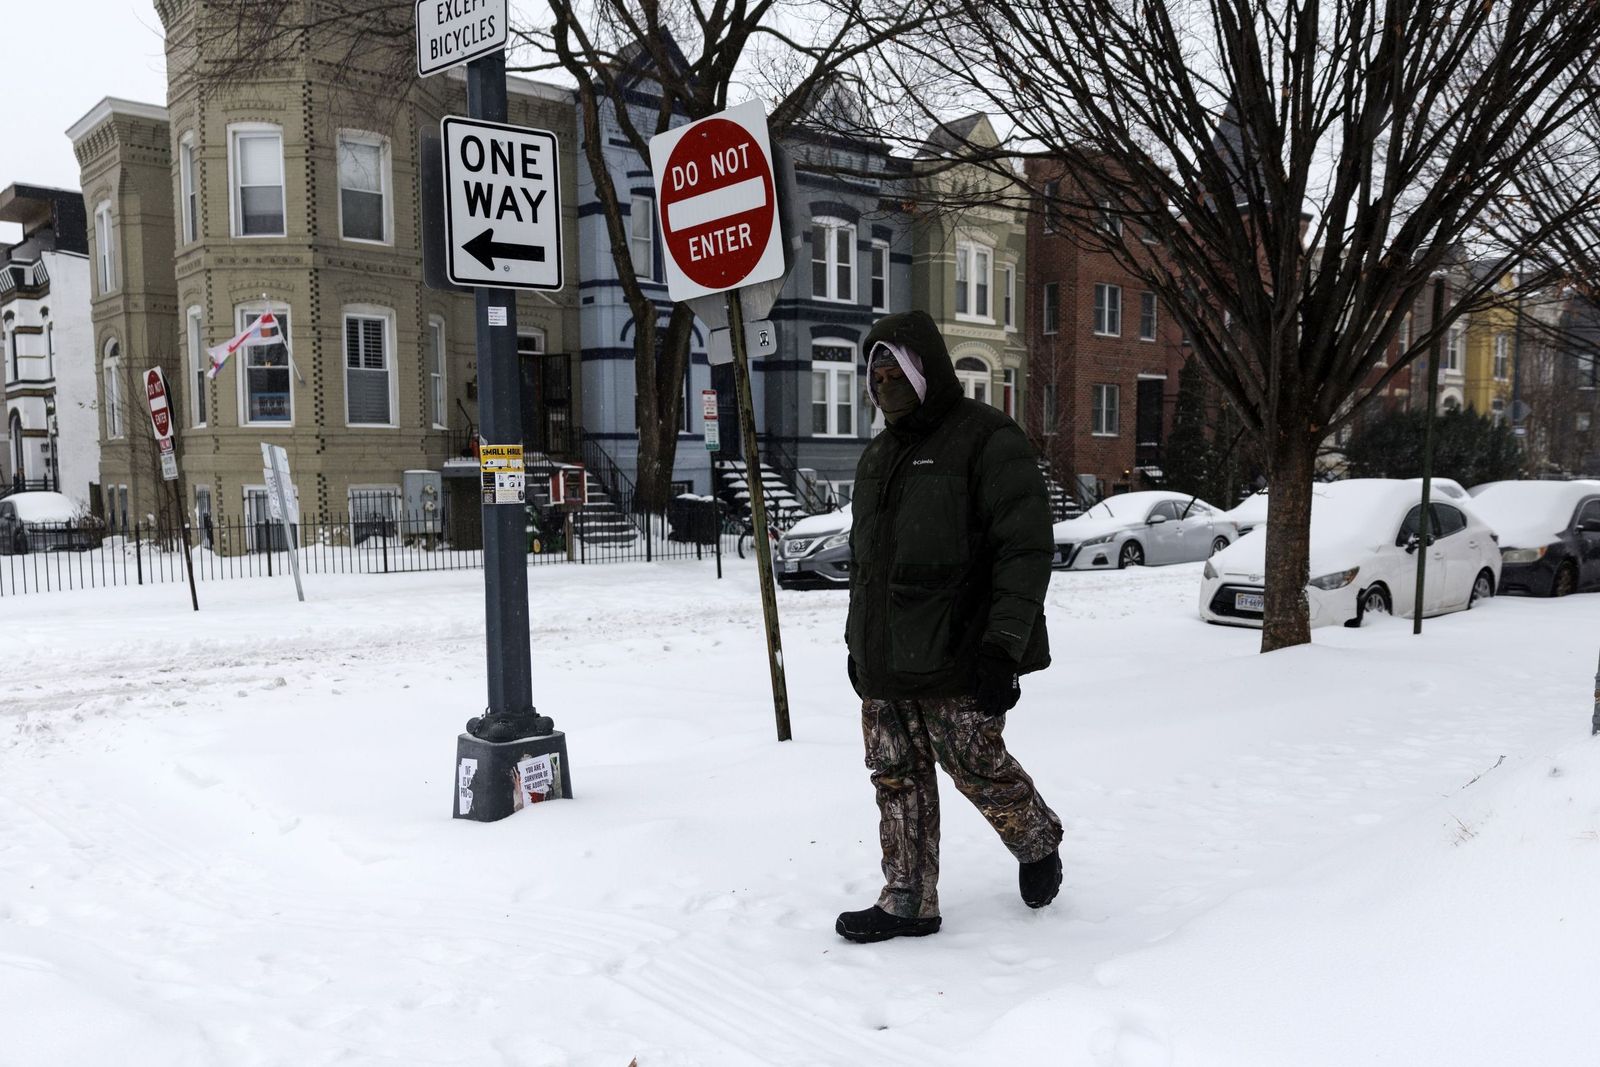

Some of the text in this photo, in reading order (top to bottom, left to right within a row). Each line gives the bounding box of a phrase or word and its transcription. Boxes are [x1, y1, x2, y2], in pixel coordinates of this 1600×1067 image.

[430, 15, 495, 60] BICYCLES
[460, 135, 543, 180] ONE
[672, 143, 750, 191] DO NOT
[463, 180, 547, 224] WAY
[688, 223, 753, 262] ENTER
[148, 383, 155, 396] DO
[155, 412, 167, 425] ENTER
[482, 448, 521, 456] SMALL HAUL
[524, 769, 548, 783] SURVIVOR OF
[525, 765, 533, 774] YOU
[533, 763, 541, 772] ARE
